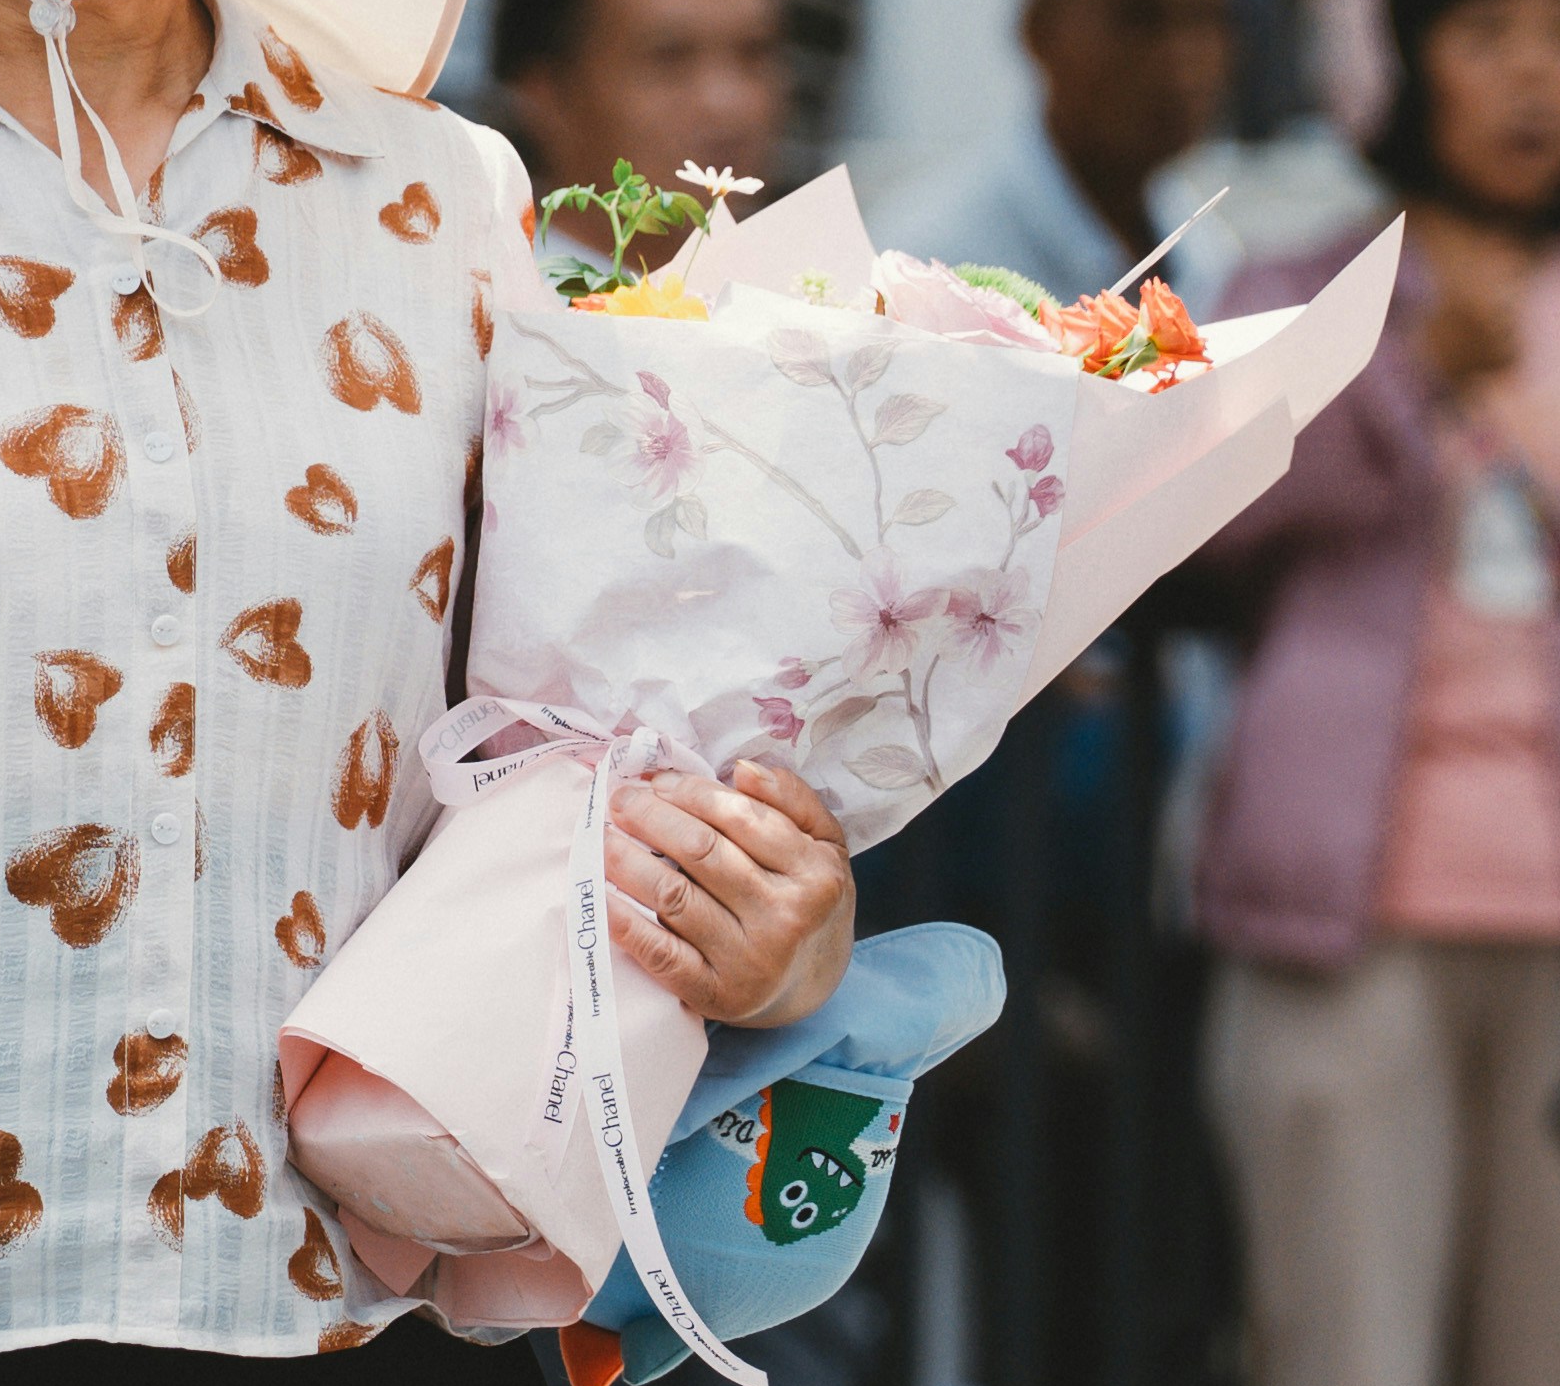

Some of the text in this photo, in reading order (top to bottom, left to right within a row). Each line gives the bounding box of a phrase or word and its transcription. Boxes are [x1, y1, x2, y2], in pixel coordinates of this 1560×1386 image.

[576, 877, 598, 951] Chanel
[544, 1049, 578, 1125] Chanel
[591, 1071, 623, 1149] Chanel
[646, 1268, 695, 1331] Chanel
